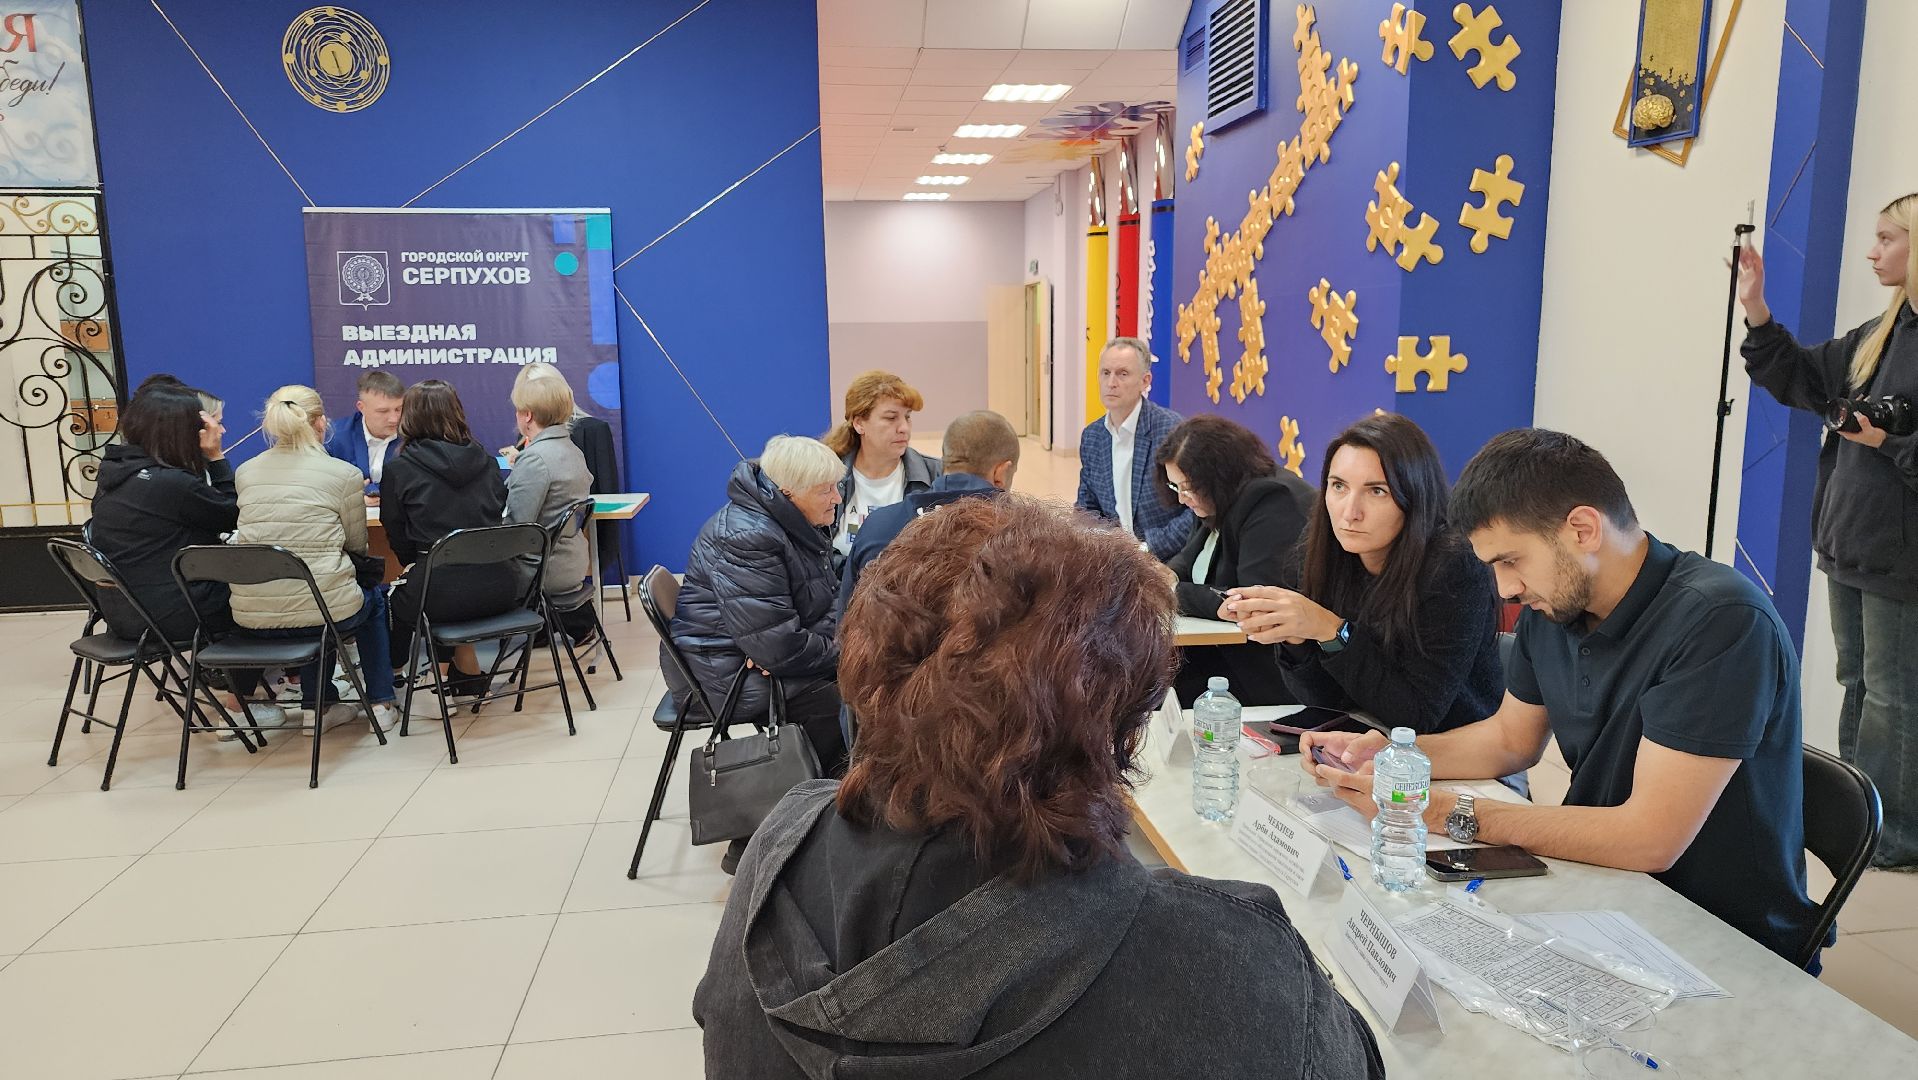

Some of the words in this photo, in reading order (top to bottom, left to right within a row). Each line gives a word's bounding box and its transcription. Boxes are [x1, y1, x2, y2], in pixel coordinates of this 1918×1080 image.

[401, 249, 484, 264] ГОРОДСКОЙ
[486, 251, 529, 263] ОКРУГ
[402, 267, 531, 285] СЕРПУХОВ
[342, 324, 477, 343] ВЫЕЗДНАЯ
[343, 347, 558, 368] АДМИНИСТРАЦИЯ
[1360, 909, 1398, 960] ЧЕРНЫШОВ
[1346, 917, 1369, 946] Андрей
[1366, 940, 1397, 983] Павлович
